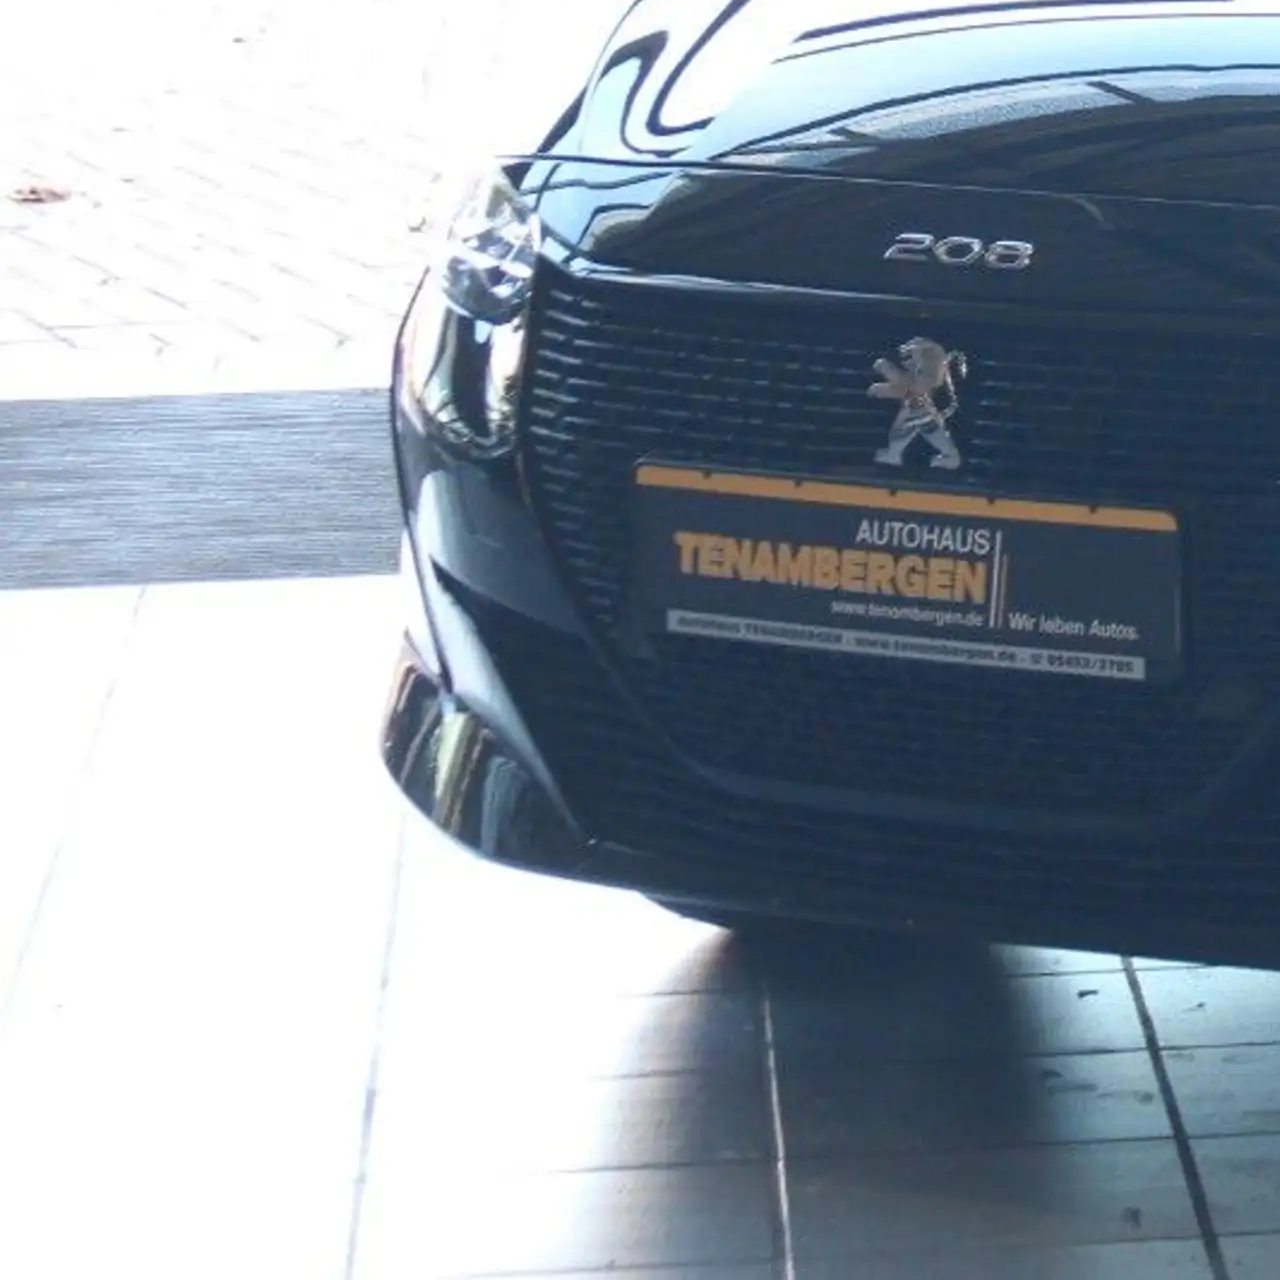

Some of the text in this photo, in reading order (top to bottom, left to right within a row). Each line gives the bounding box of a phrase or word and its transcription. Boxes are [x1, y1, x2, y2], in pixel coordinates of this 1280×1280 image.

[882, 232, 1036, 270] 208
[856, 519, 990, 554] AUTOHAUS
[674, 531, 987, 602] TENAMBERGEN
[1008, 612, 1036, 632] Wir
[1039, 613, 1084, 635] leben
